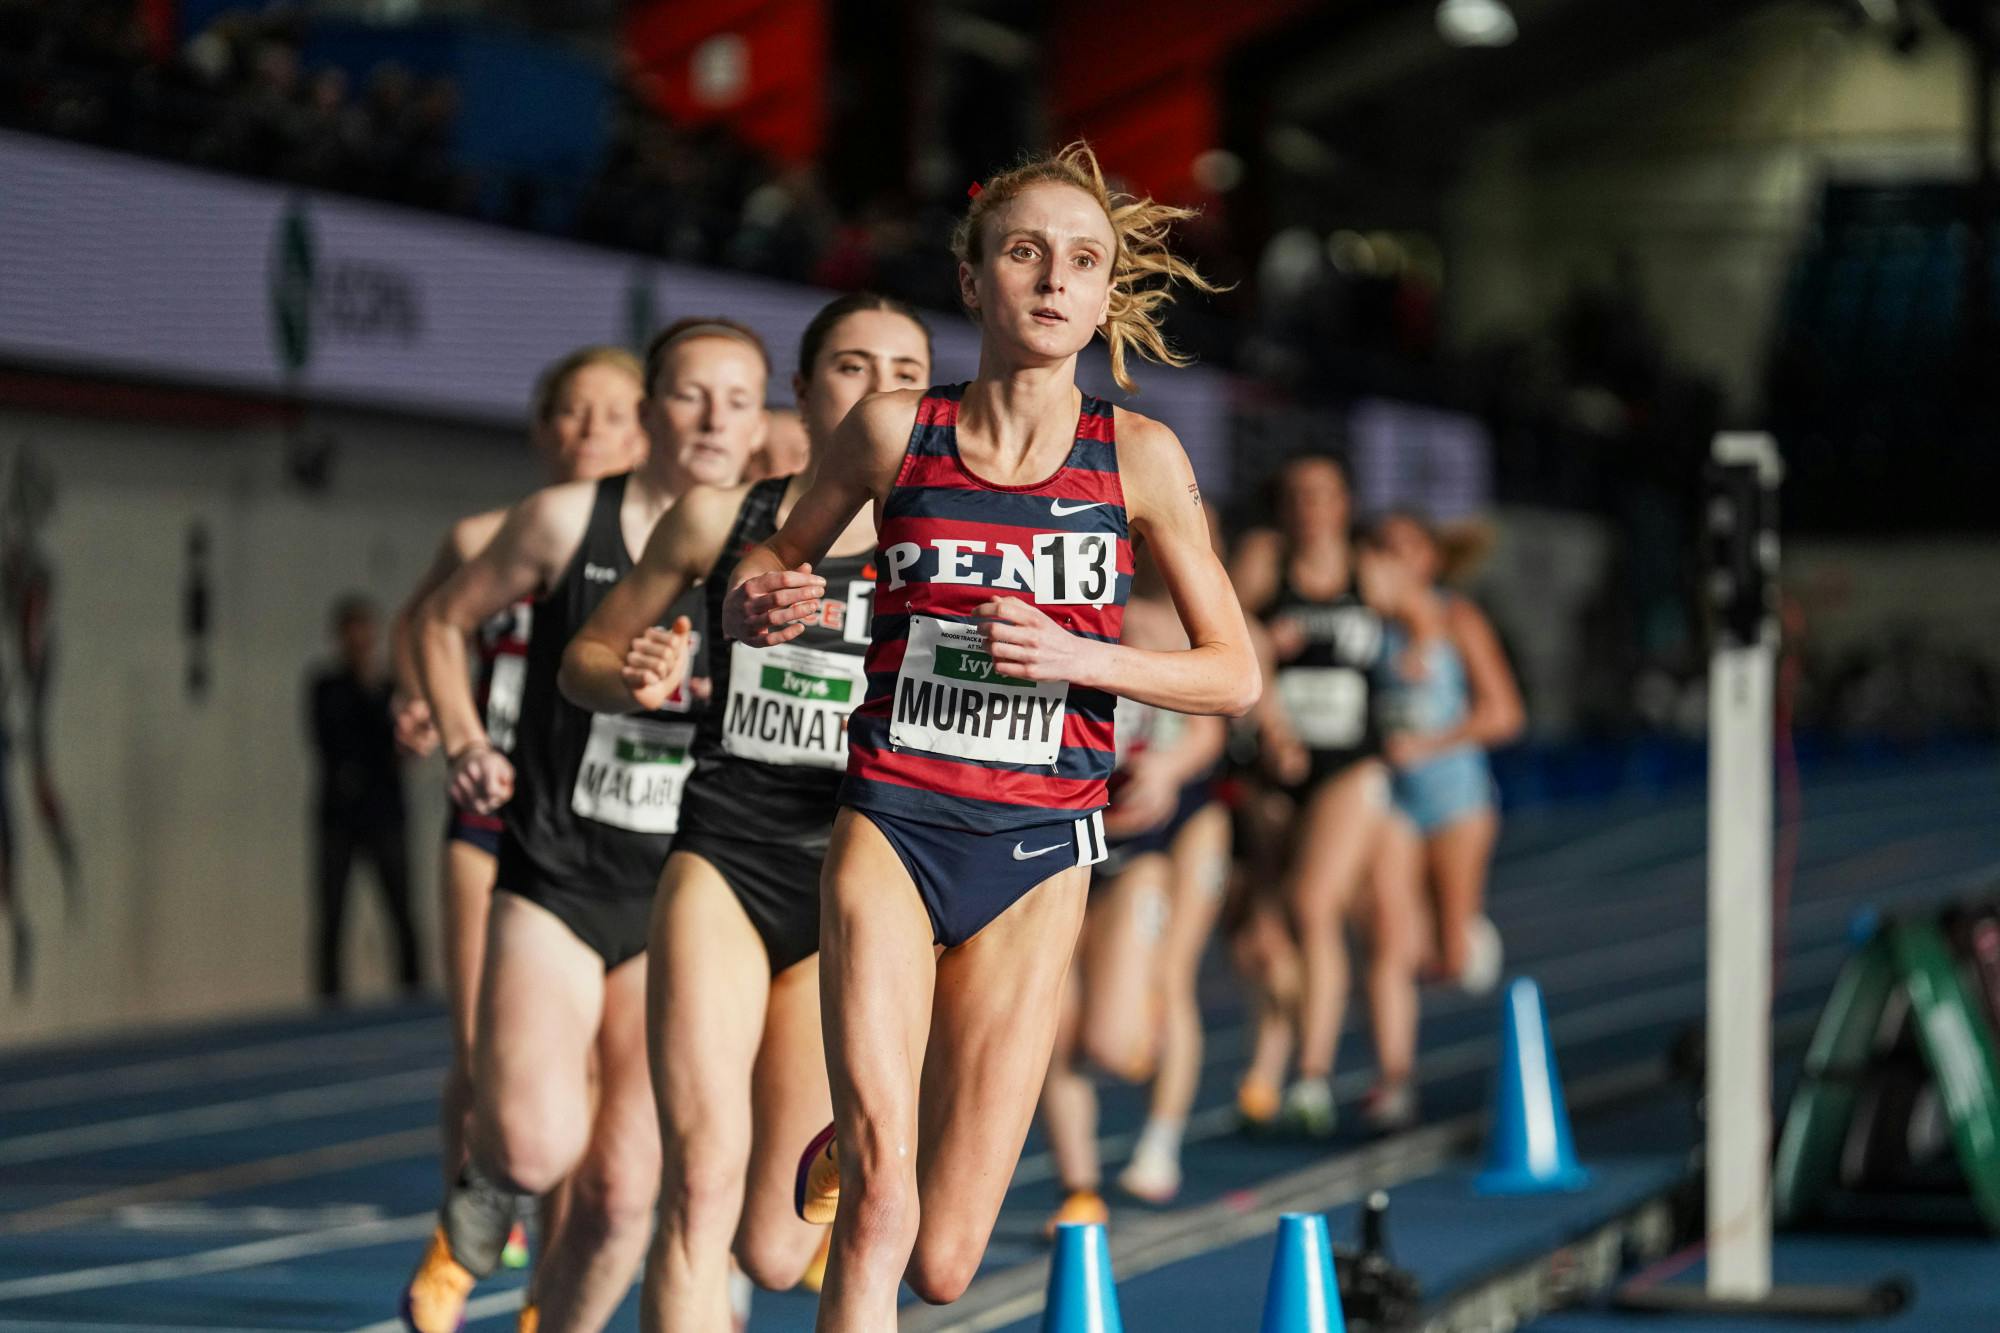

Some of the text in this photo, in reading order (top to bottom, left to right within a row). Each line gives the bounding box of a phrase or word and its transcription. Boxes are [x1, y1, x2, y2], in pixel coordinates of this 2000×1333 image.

[885, 539, 1035, 592] PEN
[1041, 535, 1107, 600] 13
[782, 672, 814, 696] Ivy
[959, 654, 993, 679] Ivy
[897, 676, 1063, 743] MURPHY
